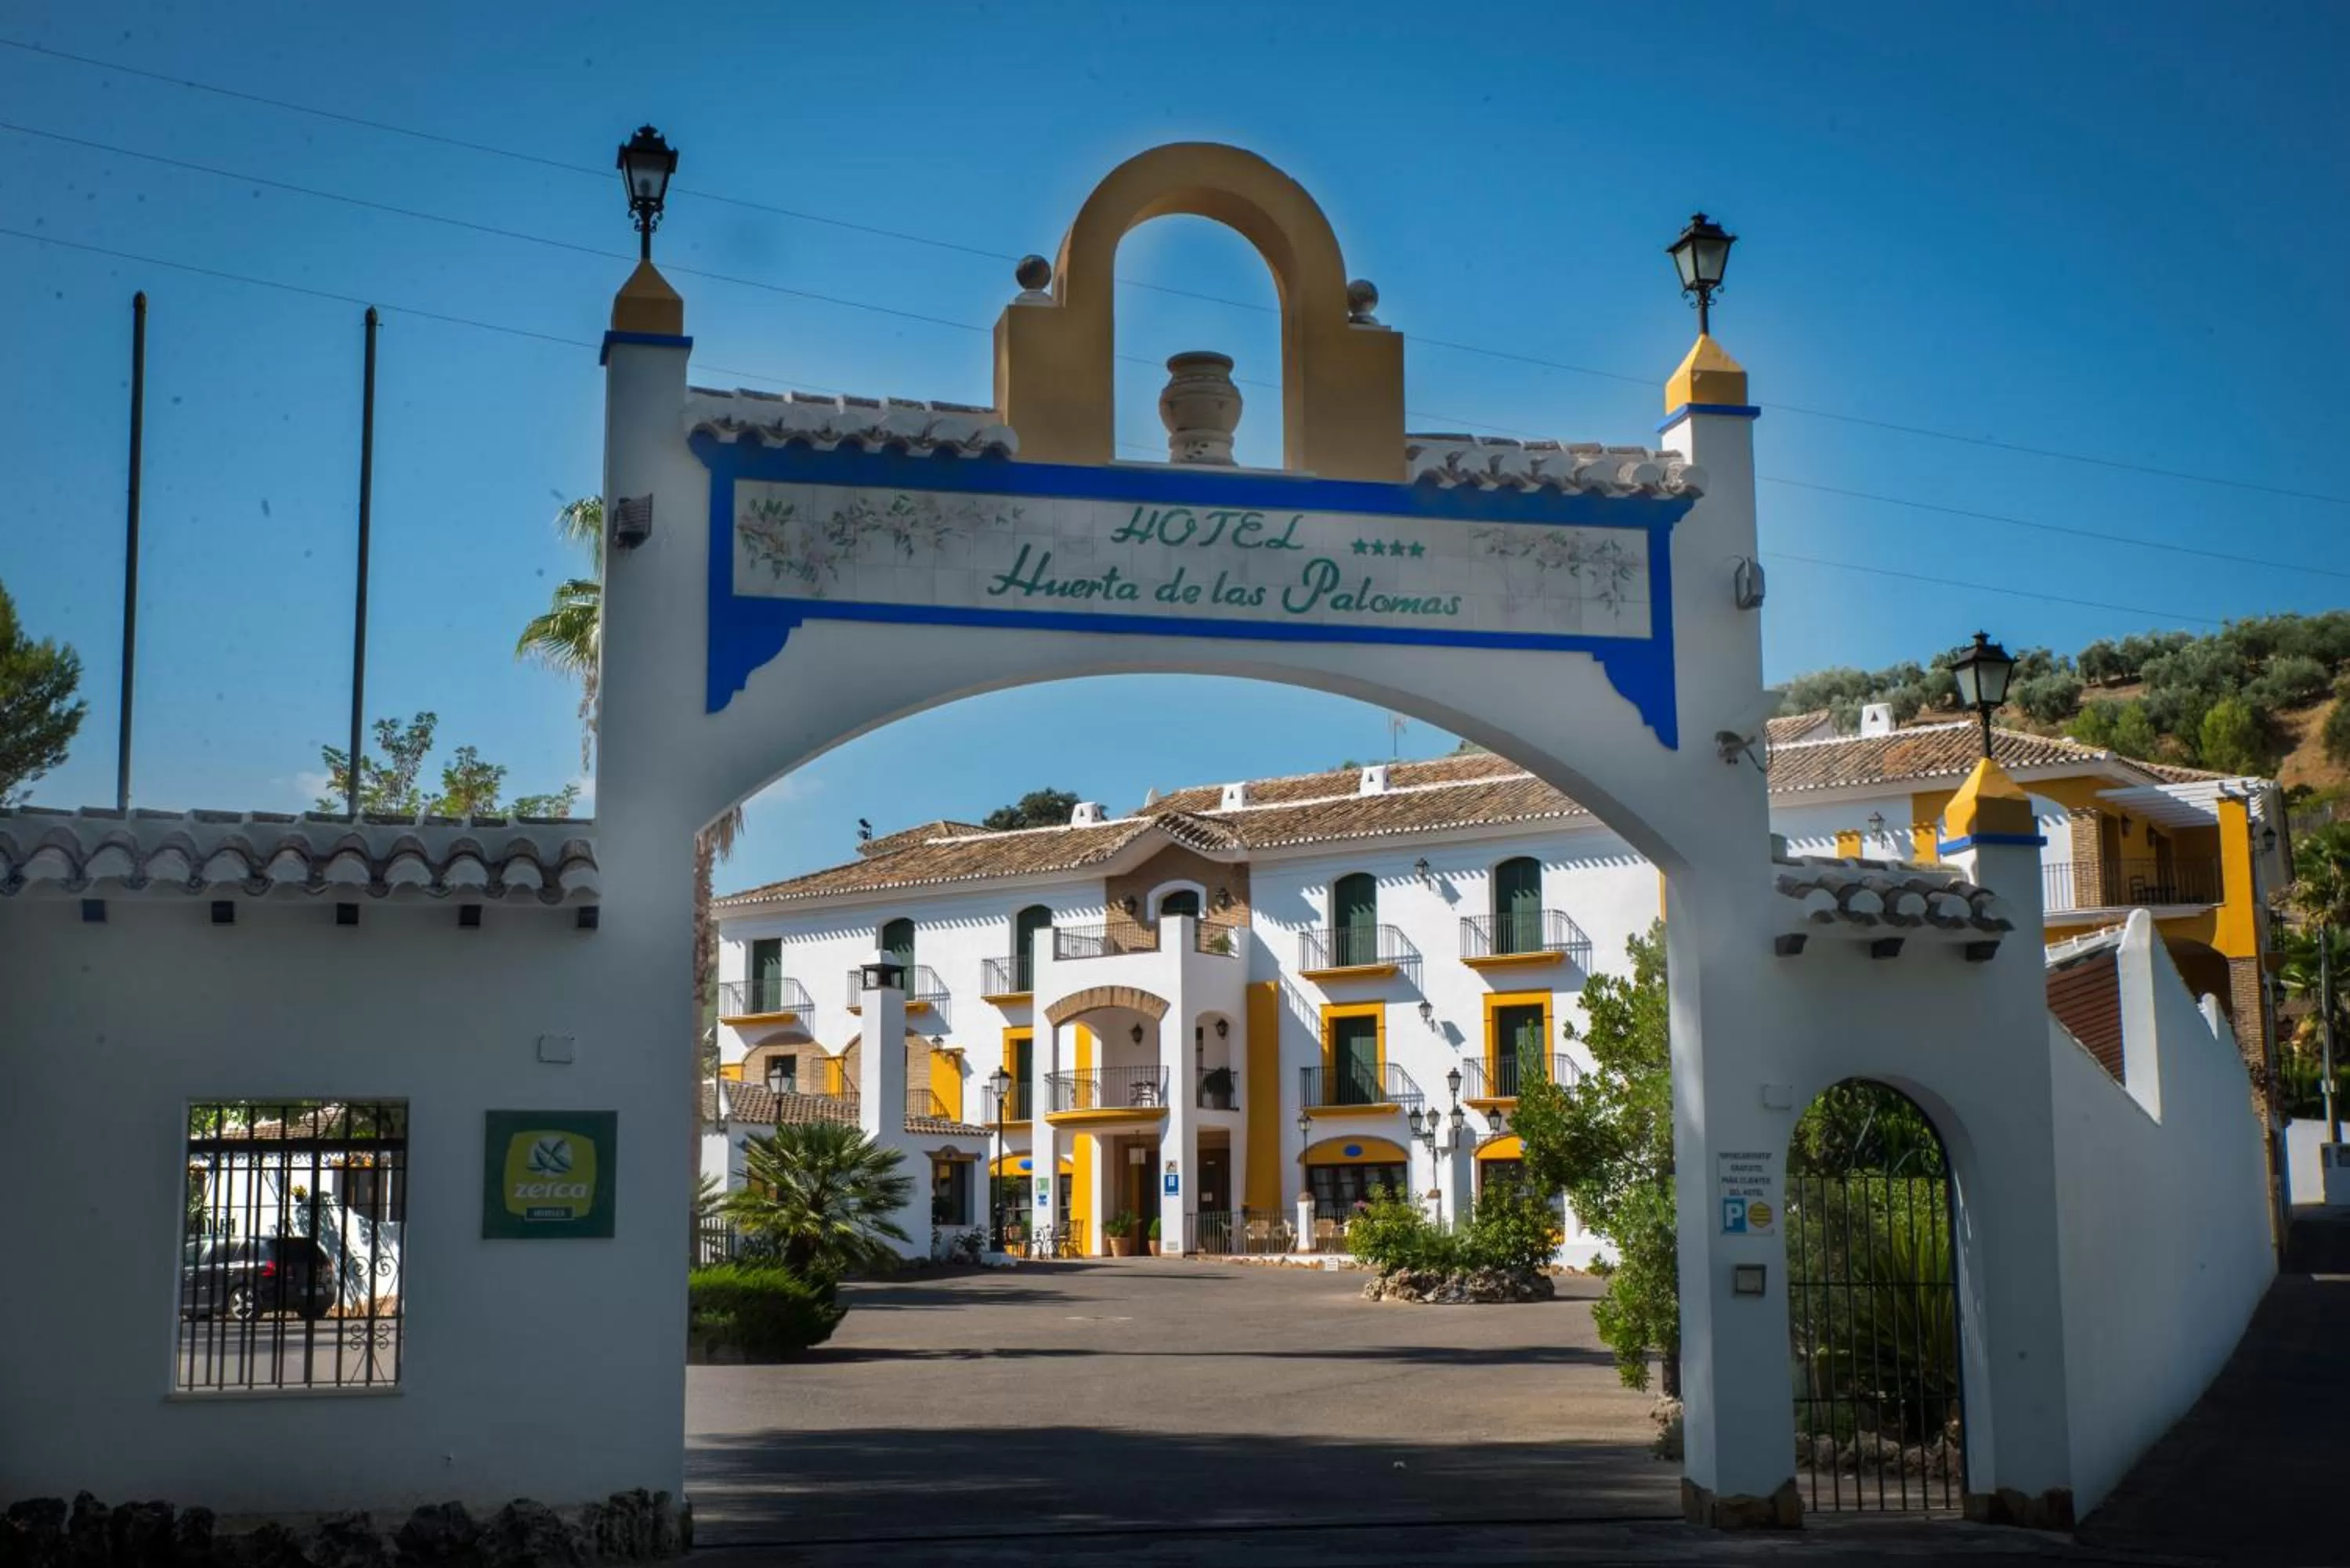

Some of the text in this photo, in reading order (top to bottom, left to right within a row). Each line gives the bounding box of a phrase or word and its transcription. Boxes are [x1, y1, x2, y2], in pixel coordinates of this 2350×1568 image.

[1111, 505, 1304, 551] HOTEL
[987, 543, 1462, 616] Huerta de las Palomas
[1726, 1202, 1743, 1228] P
